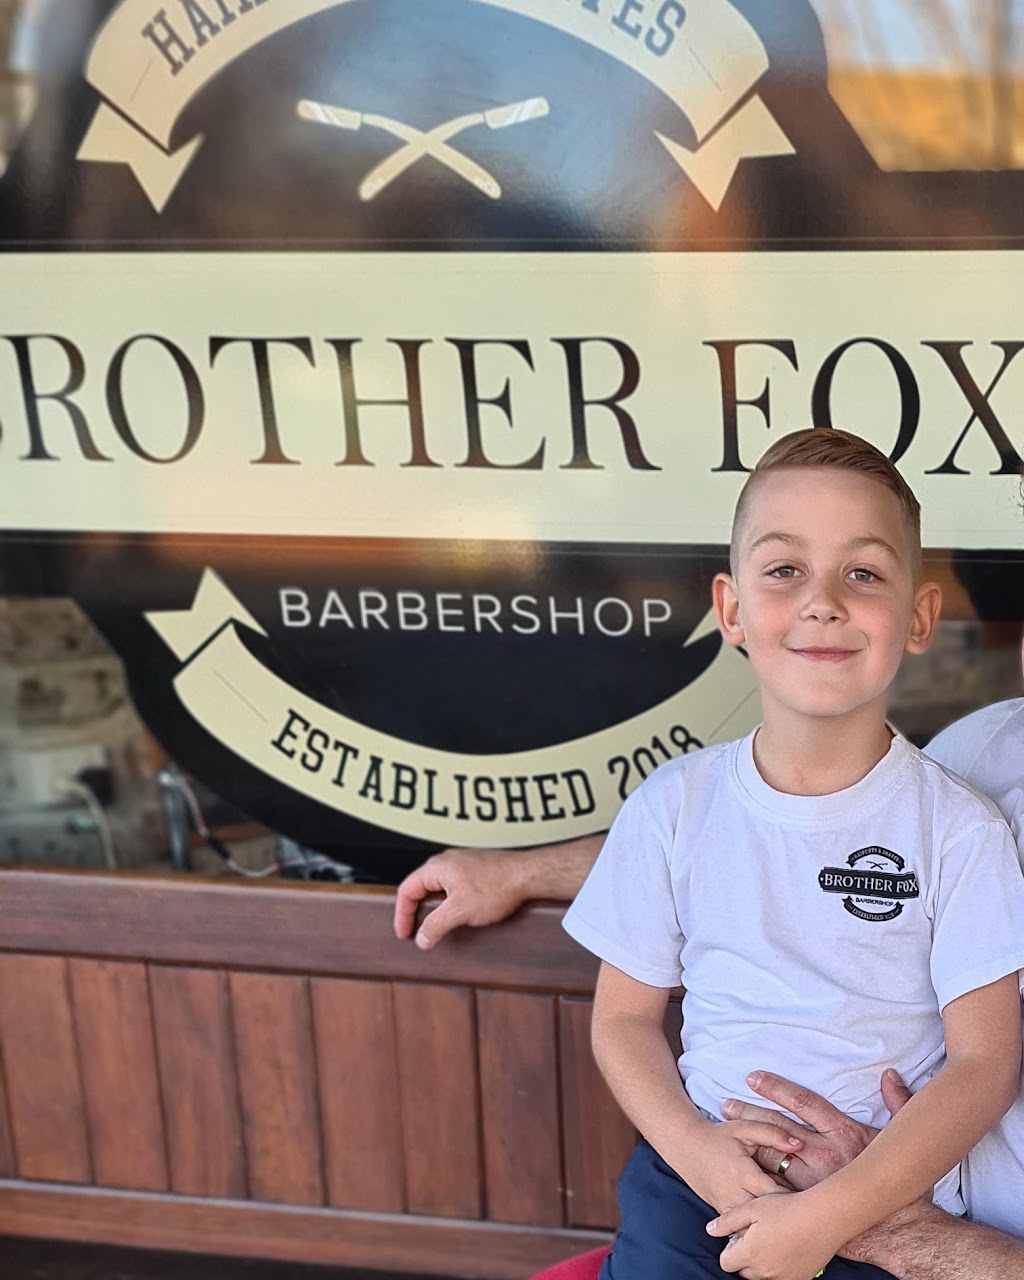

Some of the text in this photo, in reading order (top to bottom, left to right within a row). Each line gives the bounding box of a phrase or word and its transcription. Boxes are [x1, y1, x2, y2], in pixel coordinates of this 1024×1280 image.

[0, 333, 663, 473] ROTHER
[279, 587, 673, 639] BARBERSHOP
[271, 708, 705, 824] ESTABLISHED 2018
[824, 873, 918, 893] BROTHER FOX
